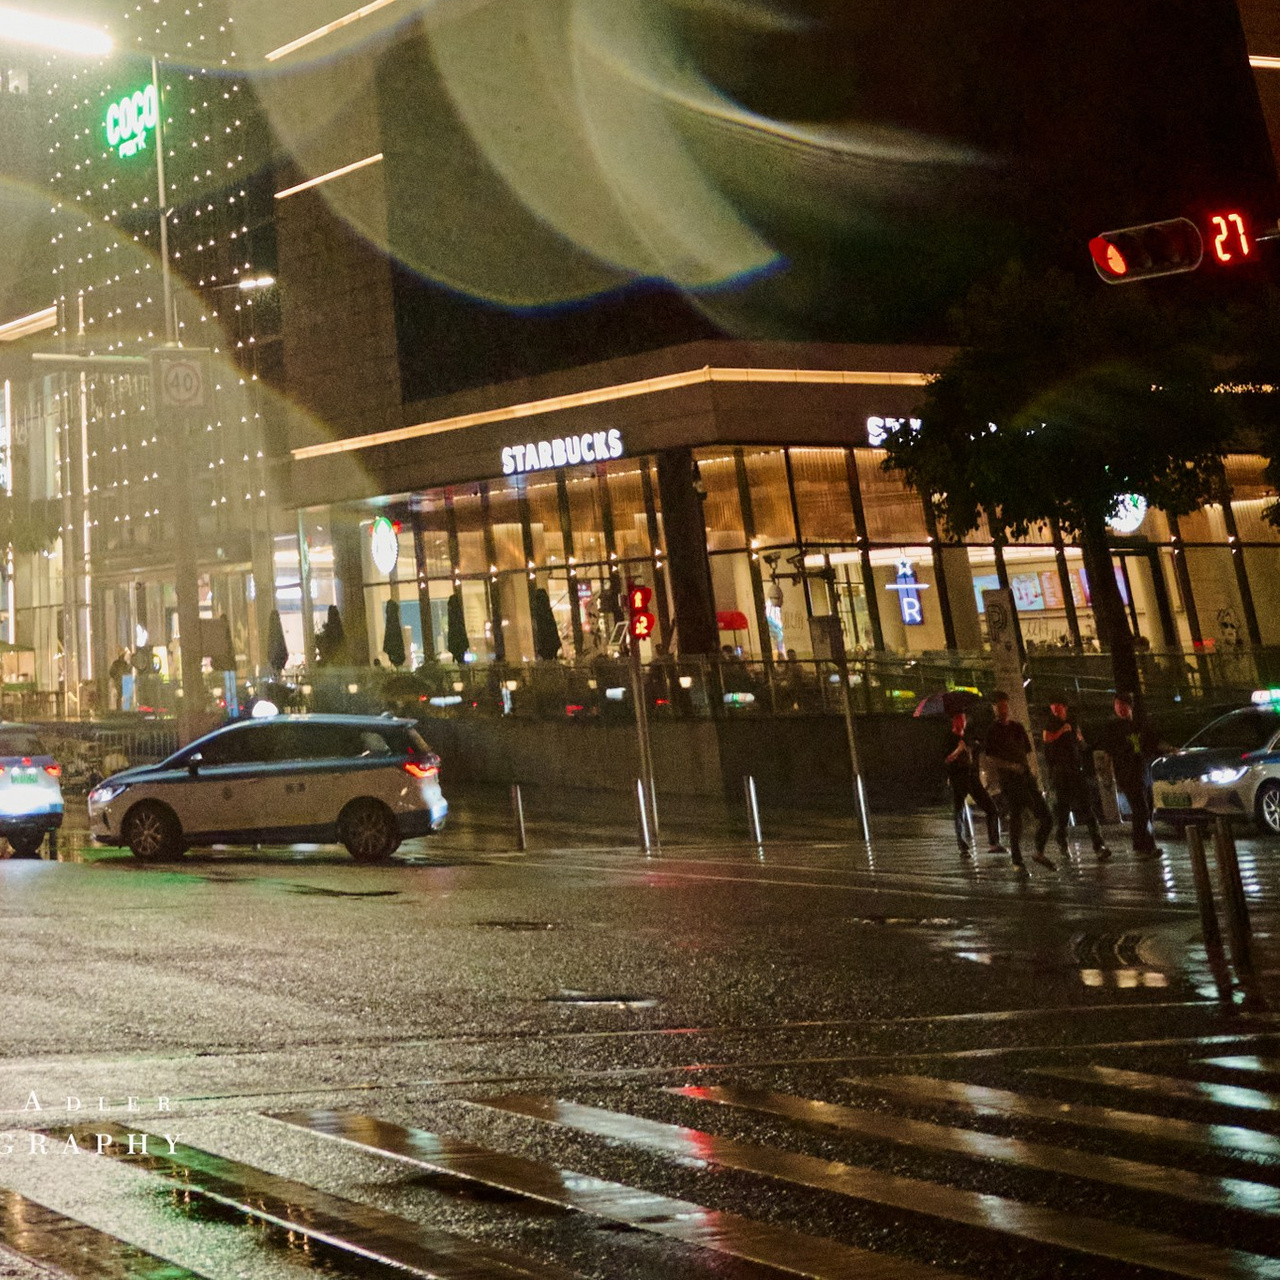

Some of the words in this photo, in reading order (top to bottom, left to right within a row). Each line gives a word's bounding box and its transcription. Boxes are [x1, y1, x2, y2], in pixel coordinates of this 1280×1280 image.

[106, 84, 157, 146] COCO
[1212, 213, 1249, 261] 27
[501, 428, 623, 475] STARBUCKS
